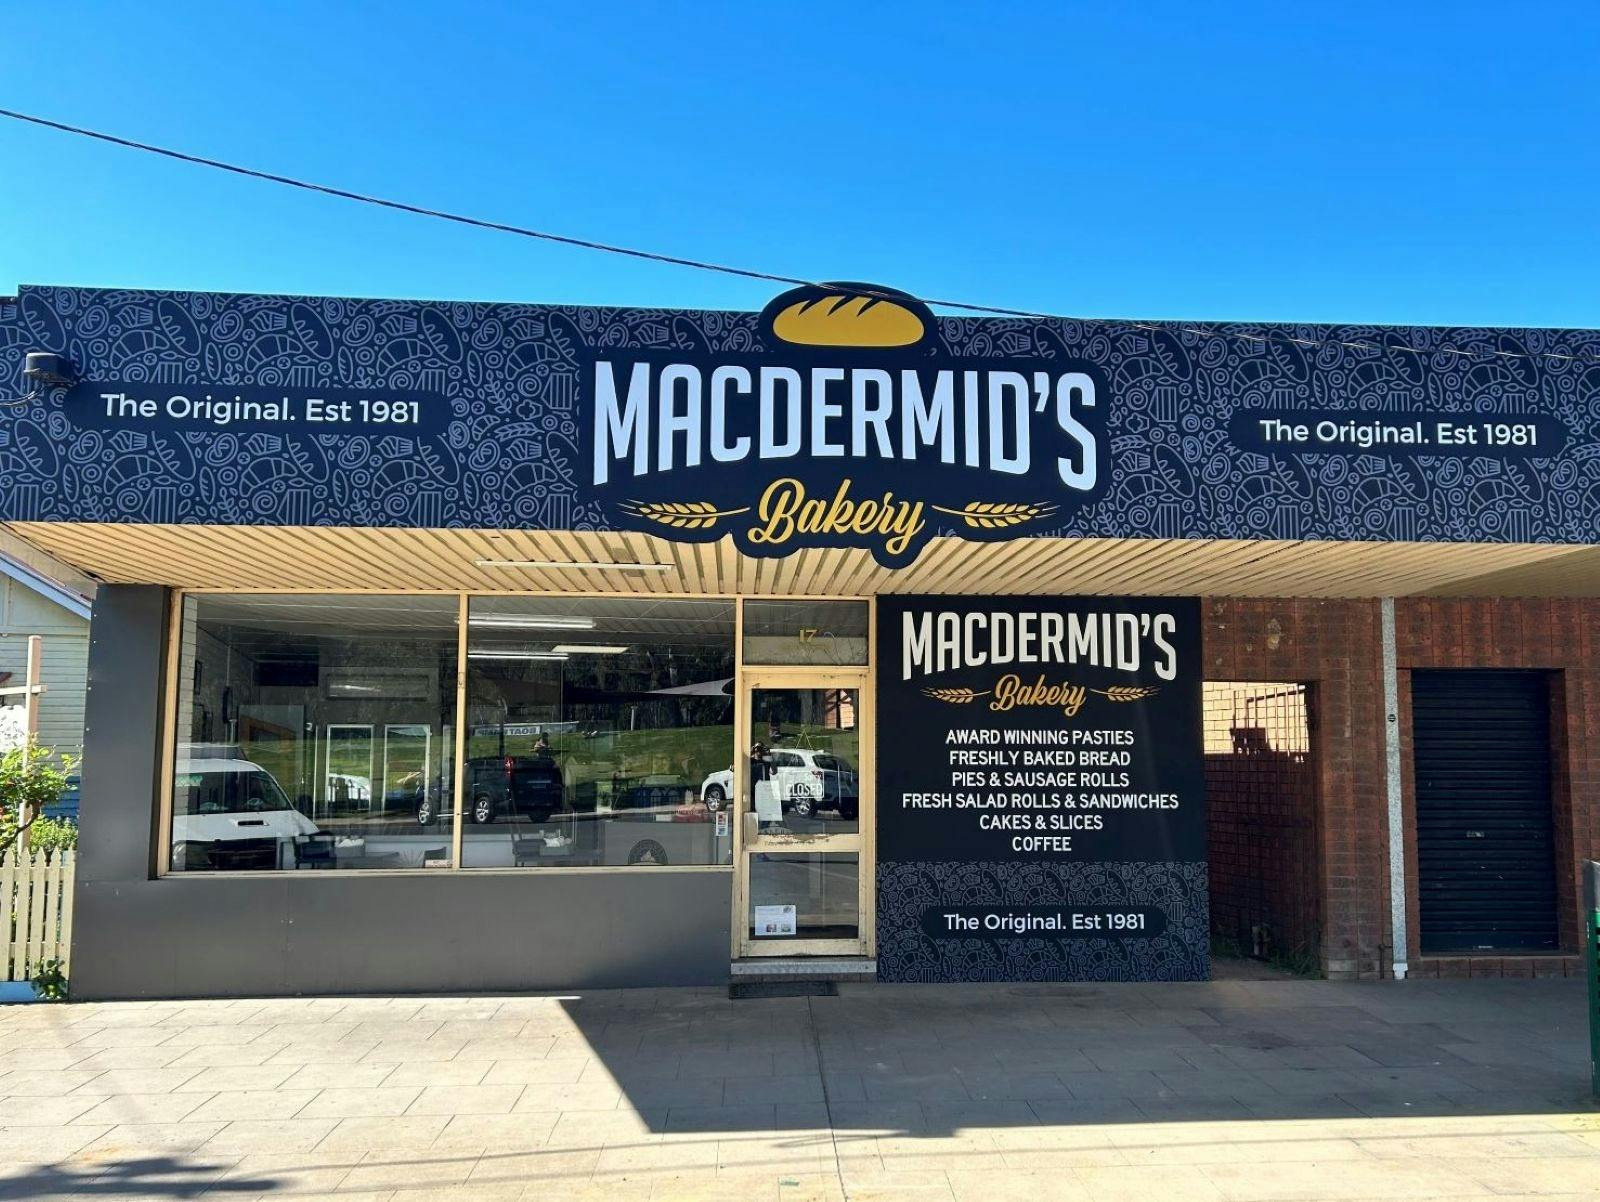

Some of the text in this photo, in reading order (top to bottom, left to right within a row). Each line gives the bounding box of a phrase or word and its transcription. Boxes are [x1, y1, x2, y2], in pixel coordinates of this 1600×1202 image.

[100, 393, 419, 425] The Original. Est 1981
[593, 360, 1097, 491] MACDERMID'S
[1259, 418, 1537, 448] The Original. Est 1981
[746, 477, 926, 555] Bakery
[799, 629, 818, 643] 17
[902, 611, 1177, 682] MACDERMID'S
[989, 673, 1087, 717] Bakery
[945, 729, 1135, 746] AWARD WINNING PASTIES
[949, 750, 1131, 766] FRESHLY BAKED BREAD
[952, 771, 1130, 788] PIES & SAUSAGE ROLLS
[785, 783, 823, 796] CLOSED
[902, 792, 1179, 809] FRESH SALAD ROLLS & SANDWICHES
[979, 814, 1104, 830] CAKES & SLICES
[1012, 836, 1072, 852] COFFEE
[943, 912, 1145, 934] The Original. Est 1981
